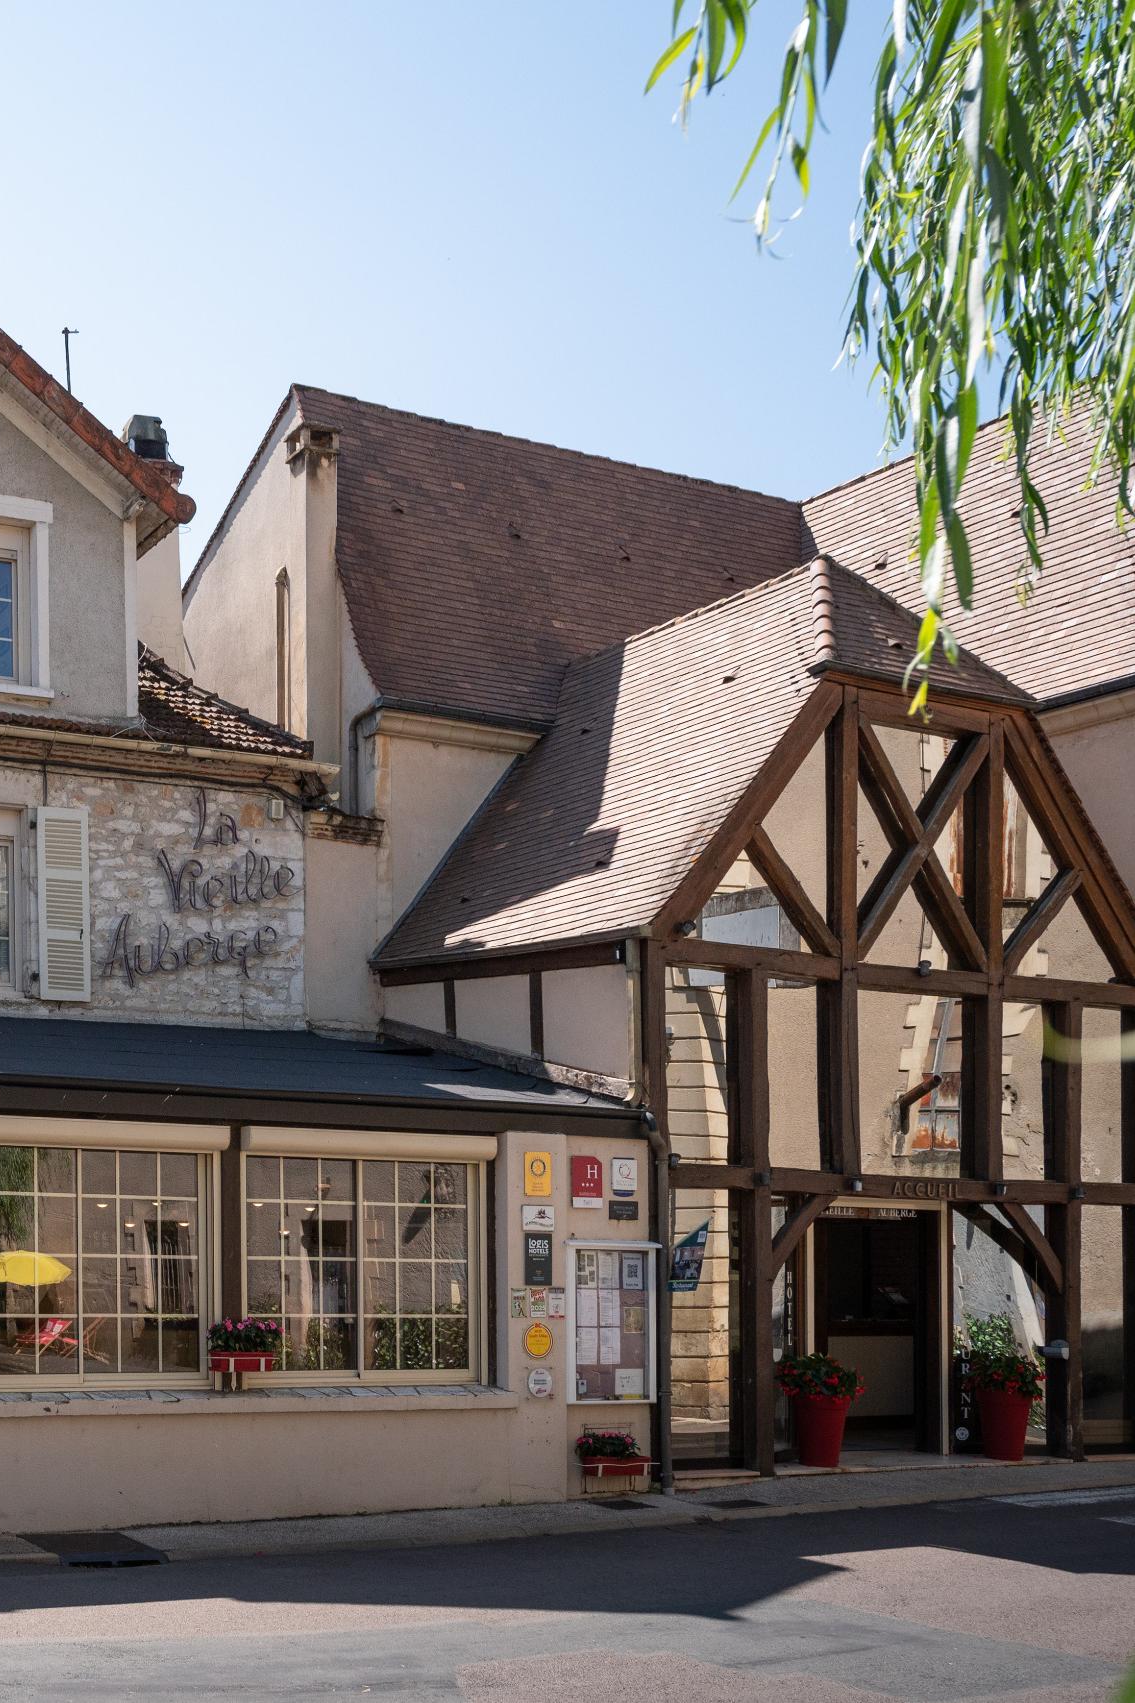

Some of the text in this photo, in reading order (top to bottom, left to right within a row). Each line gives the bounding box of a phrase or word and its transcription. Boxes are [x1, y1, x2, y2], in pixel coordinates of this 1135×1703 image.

[192, 786, 240, 850] La
[157, 848, 304, 913] Vieille
[101, 912, 281, 989] Auberge
[586, 1164, 599, 1179] H
[893, 1181, 964, 1198] ACCUEIL
[821, 1206, 917, 1218] IEILLE AUBERGE
